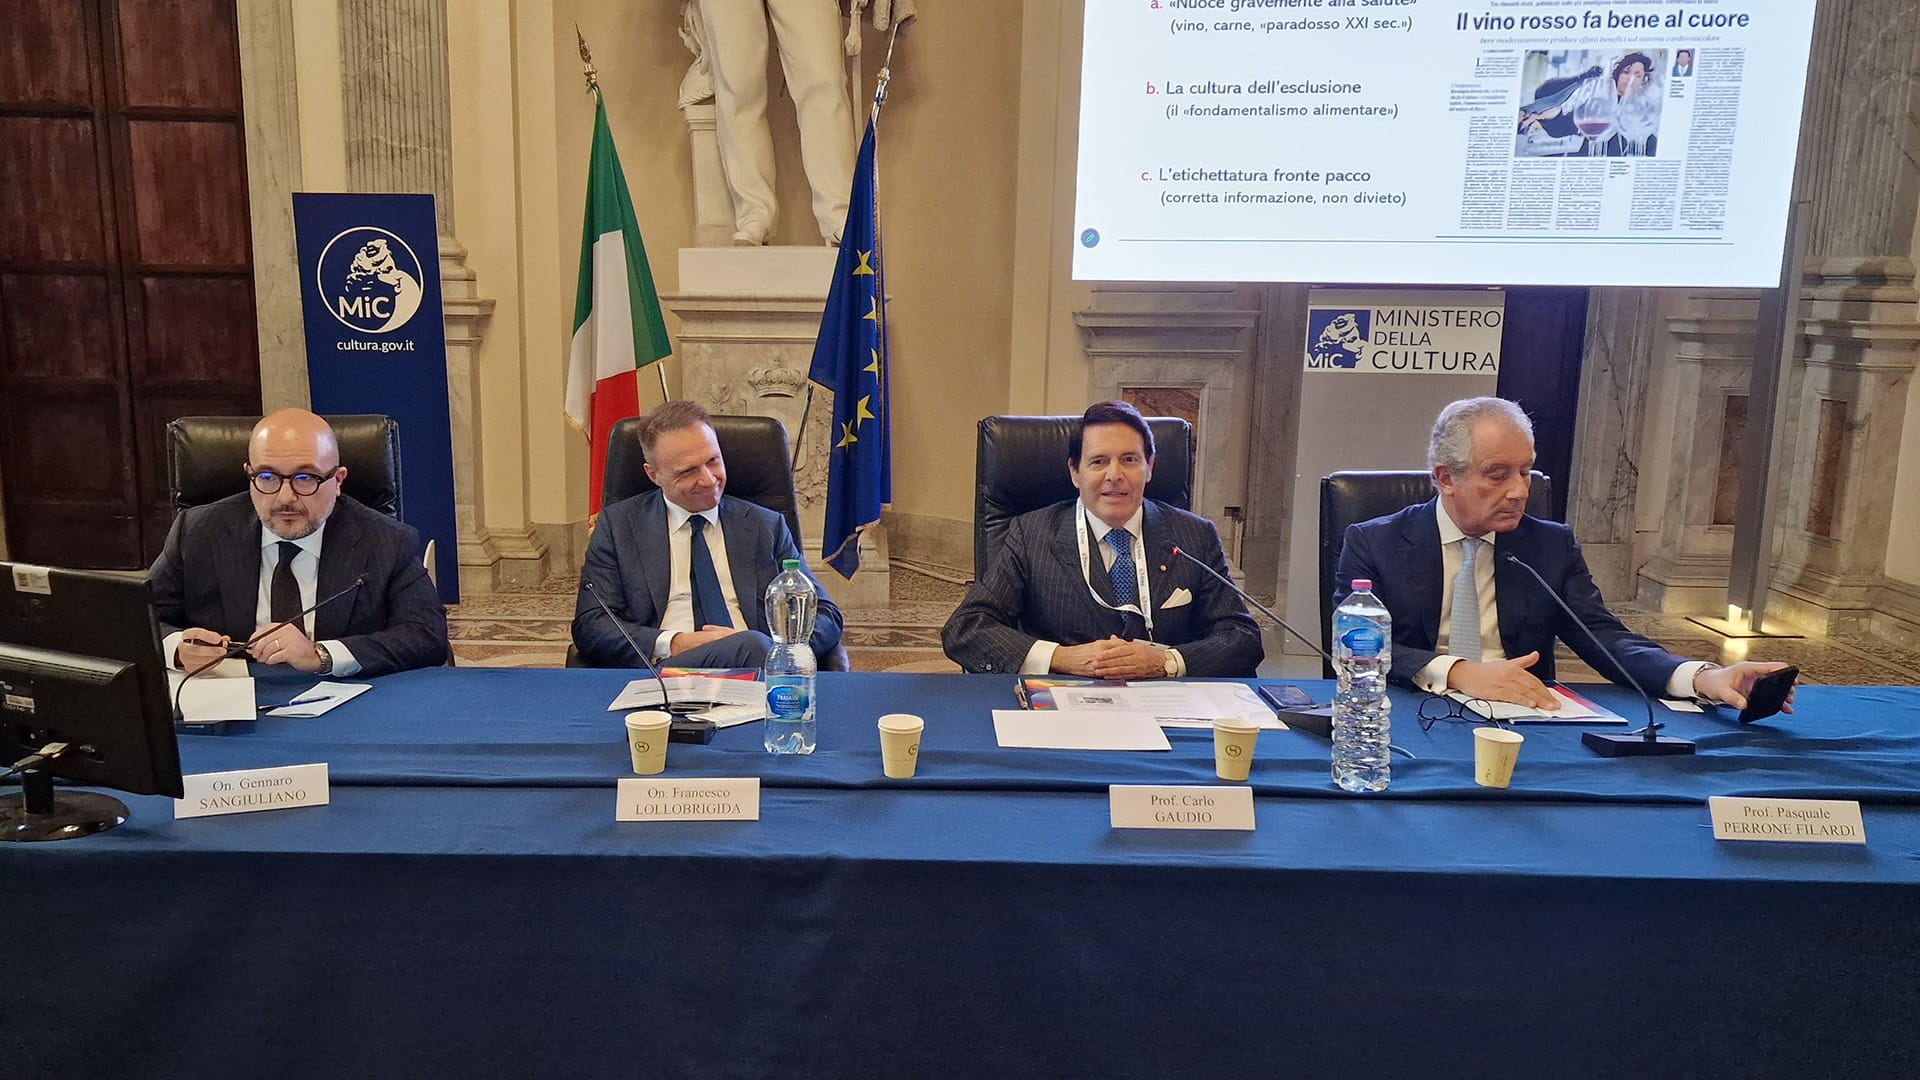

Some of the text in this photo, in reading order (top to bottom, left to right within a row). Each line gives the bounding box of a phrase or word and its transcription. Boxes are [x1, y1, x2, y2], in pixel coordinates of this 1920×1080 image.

[1150, 0, 1163, 9] a.
[1230, 0, 1323, 12] gravemente
[1170, 15, 1413, 35] (vino, carne, «paradosso XXI sec.»)
[1456, 9, 1750, 31] Il vino rosso fa bene al cuore
[1146, 79, 1362, 95] b. La cultura dell'esclusione
[1165, 103, 1399, 120] (il «fondamentalismo alimentare»)
[1141, 167, 1372, 186] c. L'etichettatura fronte pacco
[1160, 190, 1407, 207] (corretta informazione, non divieto)
[338, 296, 391, 319] MiC
[1375, 309, 1501, 328] MINISTERO
[336, 339, 415, 353] cultura.gov.it
[1374, 331, 1432, 346] DELLA
[1307, 353, 1343, 369] MiC
[1372, 350, 1497, 371] CULTURA
[212, 776, 293, 792] On. Gennaro
[199, 789, 306, 810] SANGIULIANO
[647, 787, 731, 799] On. Francesco
[1150, 794, 1215, 807] Prof. Carlo
[635, 803, 742, 816] LOLLOBRIGIDA
[1154, 811, 1212, 824] GAUDIO
[1743, 806, 1831, 822] Prof. Pasquale
[1723, 821, 1857, 837] PERRONE FILARDI
